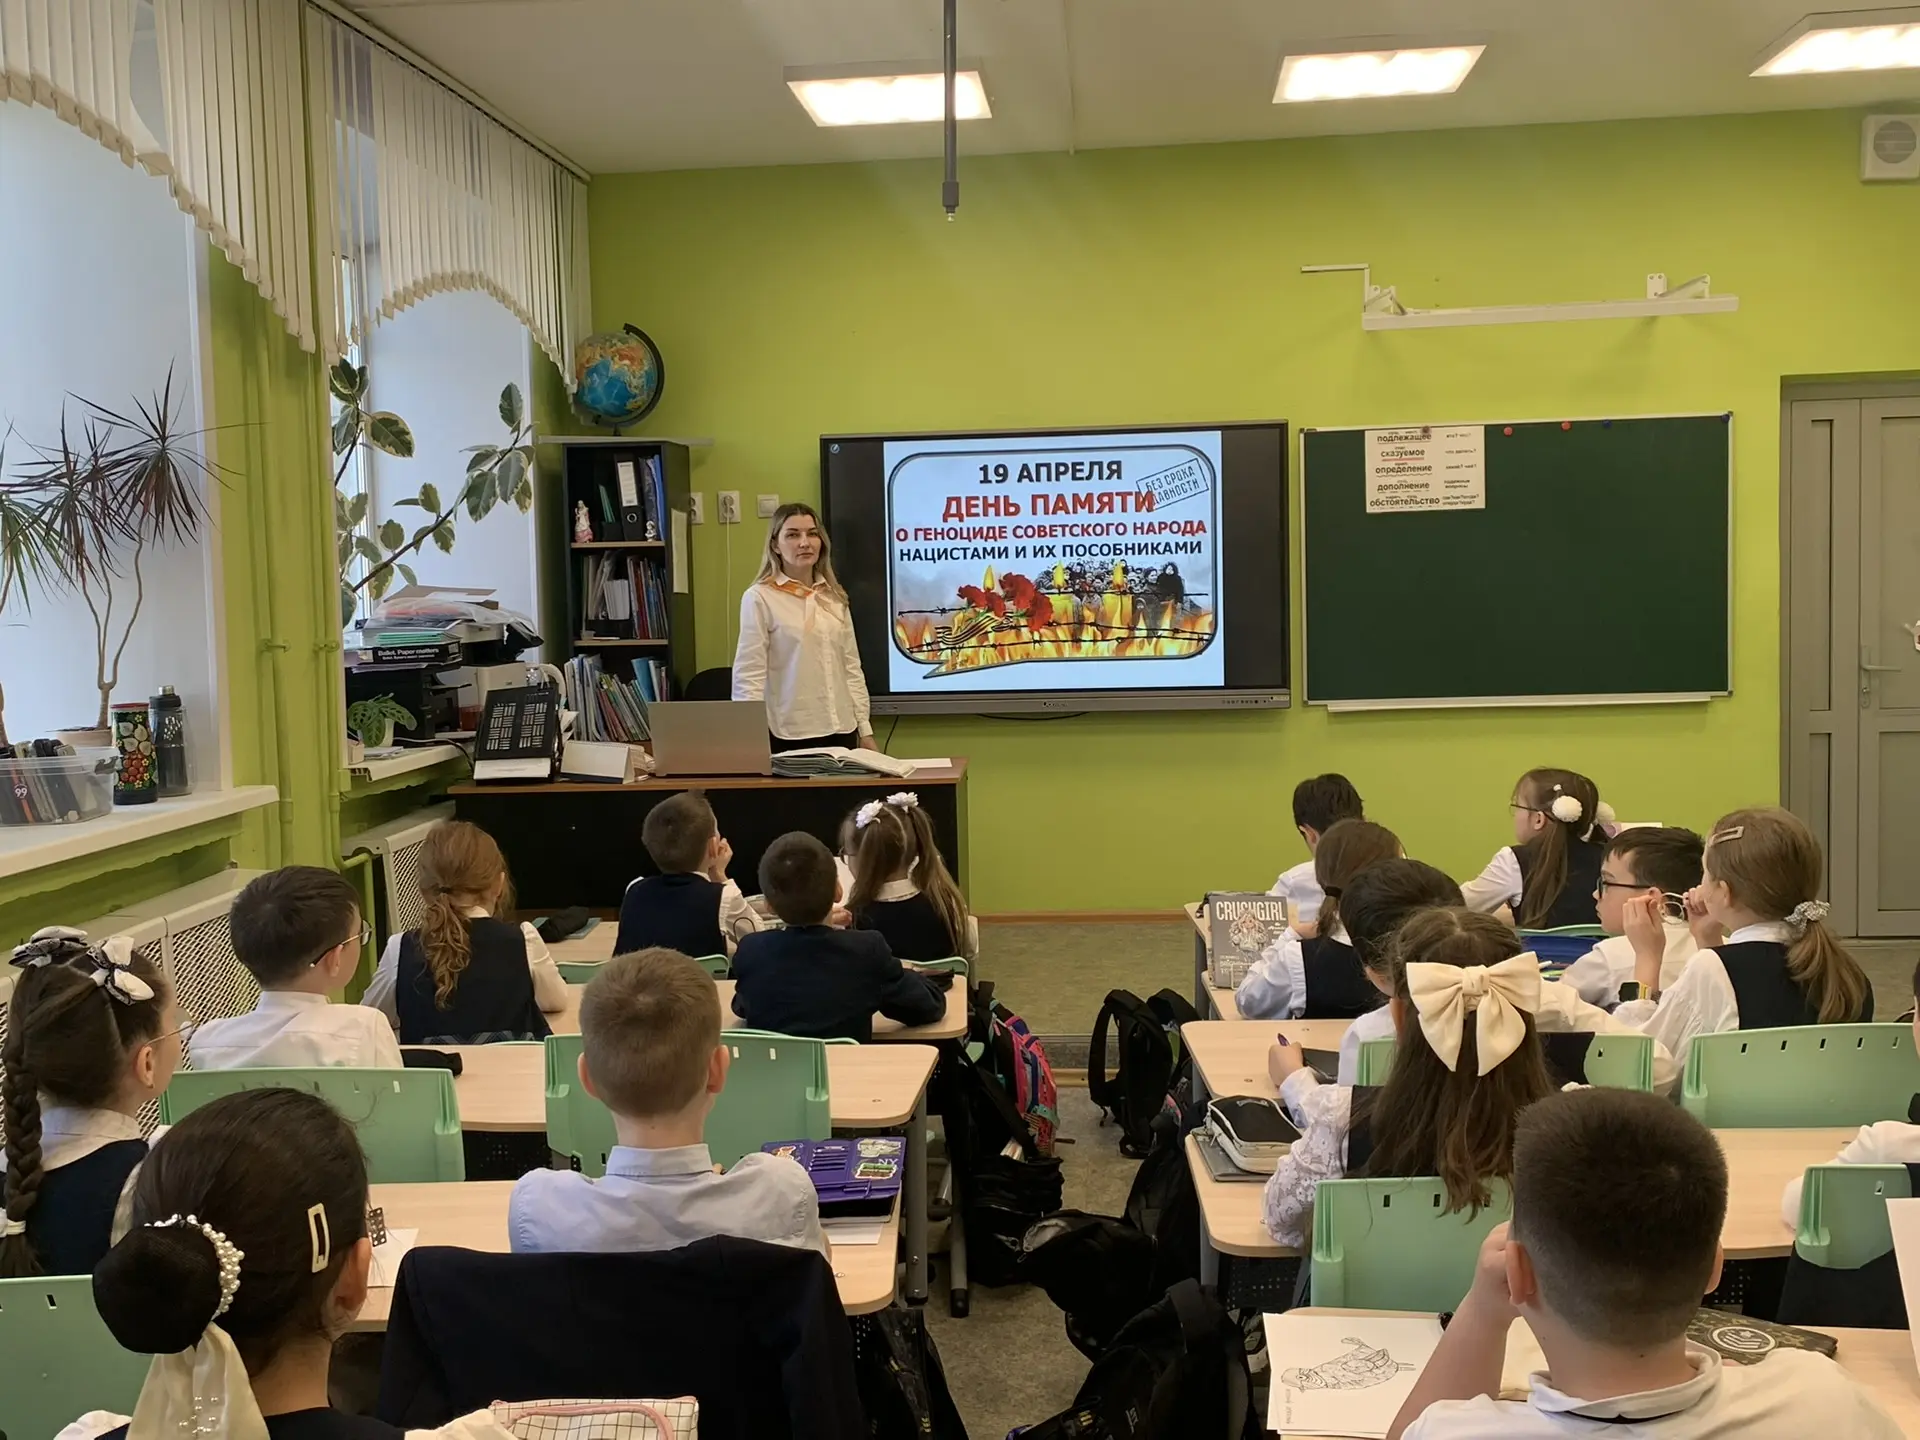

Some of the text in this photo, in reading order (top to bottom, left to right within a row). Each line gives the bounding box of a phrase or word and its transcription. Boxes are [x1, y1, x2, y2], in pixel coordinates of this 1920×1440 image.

[1380, 449, 1425, 458] сказуемое
[979, 460, 1122, 484] 19 АПРЕЛЯ
[1145, 465, 1196, 492] БЕЗ СРОКА
[1375, 465, 1433, 474] определение
[1377, 482, 1430, 491] дополнение
[942, 490, 1156, 523] ДЕНЬ ПАМЯТИ
[1369, 497, 1440, 507] обстоятельство
[895, 520, 1207, 543] О ГЕНОЦИДЕ СОВЕТСКОГО НАРОДА
[900, 541, 1202, 563] НАЦИСТАМИ И ИХ ПОСОБНИКАМИ
